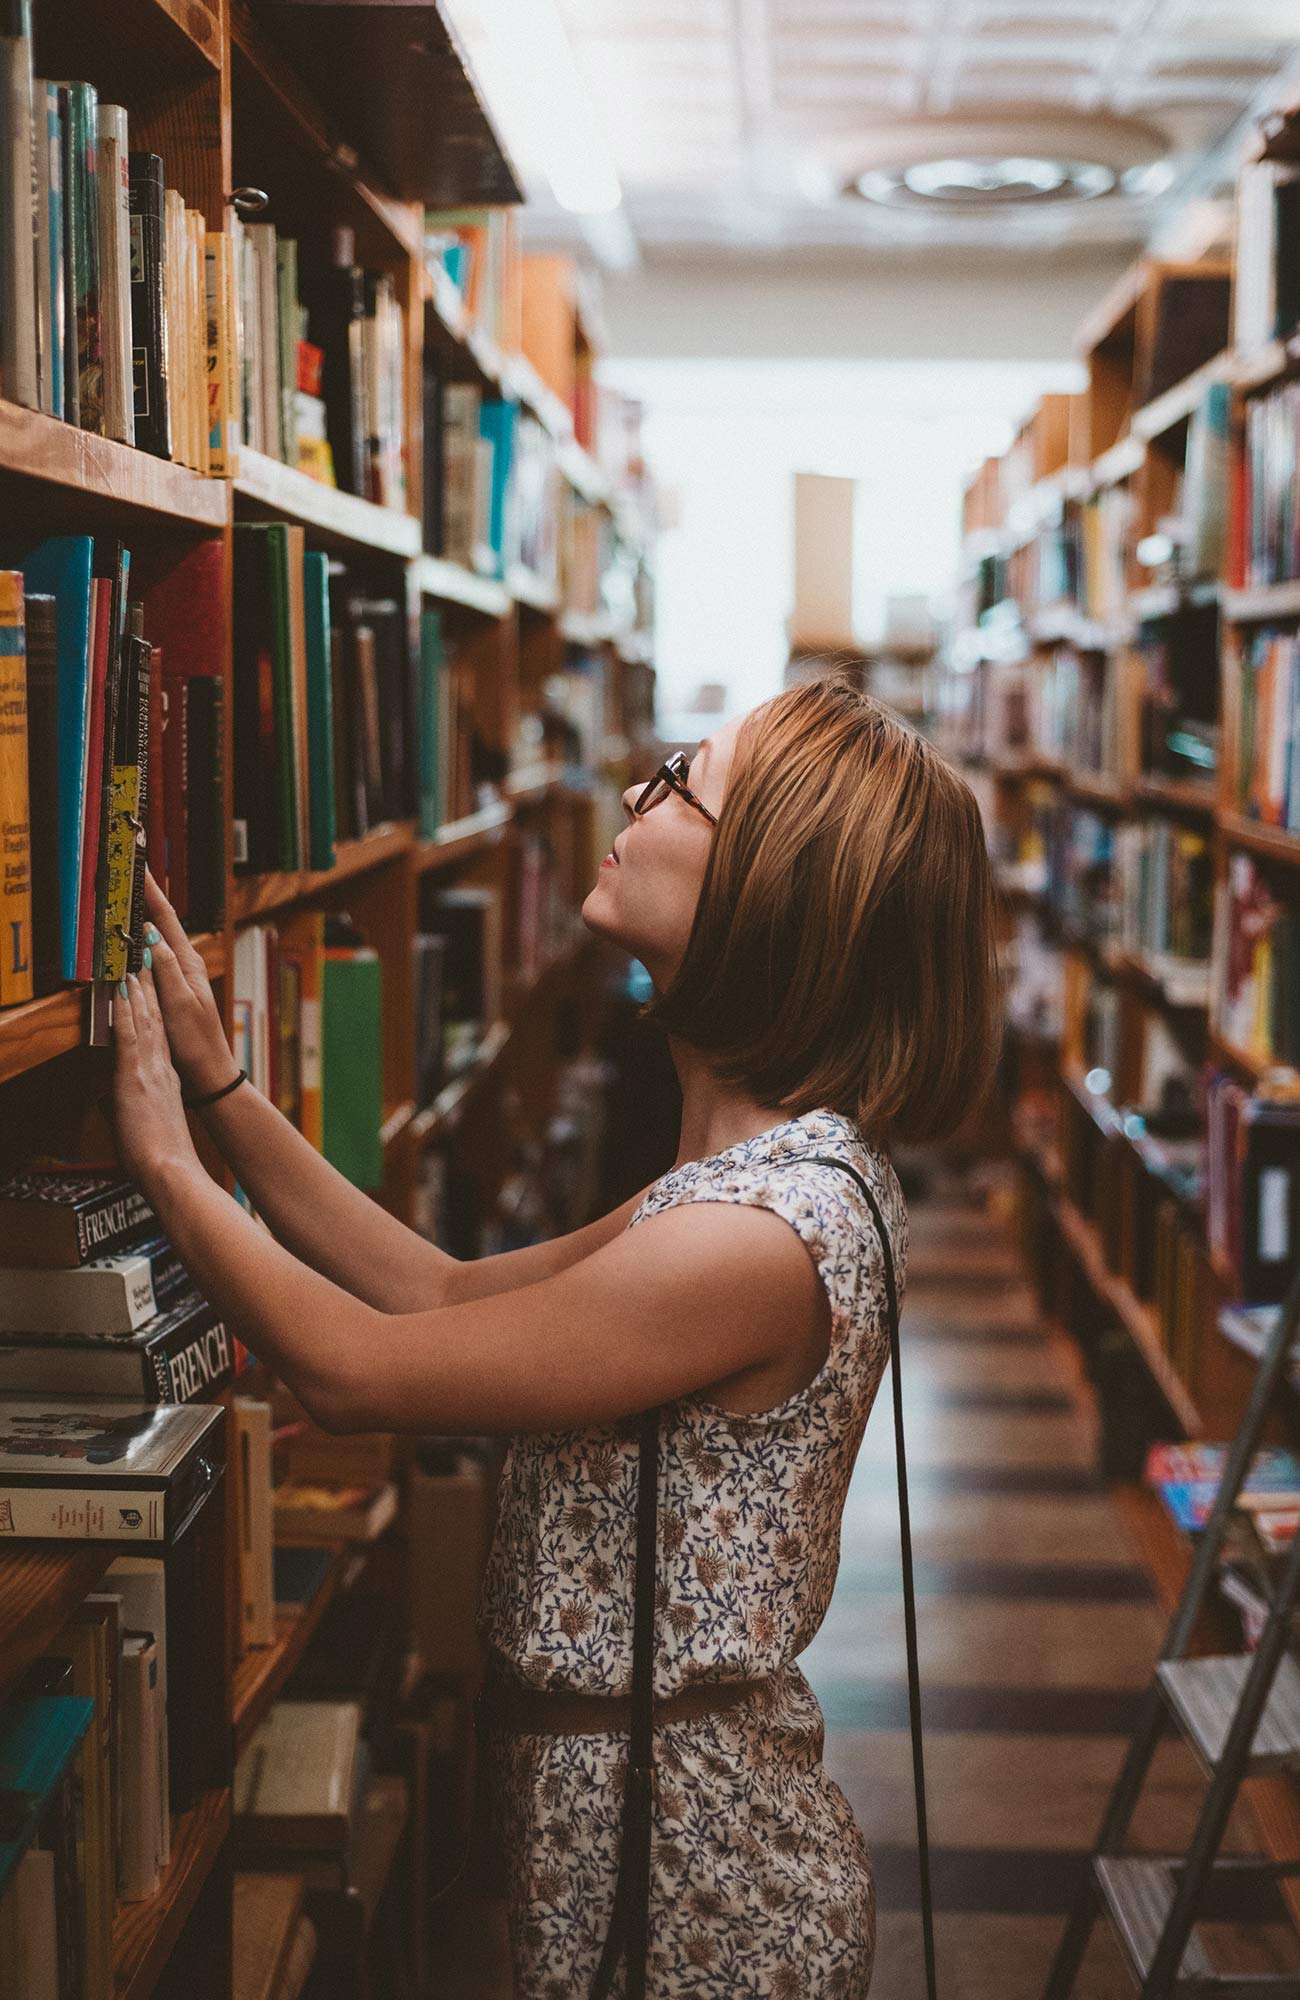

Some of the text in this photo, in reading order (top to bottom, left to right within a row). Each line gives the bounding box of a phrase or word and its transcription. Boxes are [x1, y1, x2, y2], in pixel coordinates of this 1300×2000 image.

[10, 921, 28, 974] L
[77, 1212, 88, 1257] Oxford
[85, 1199, 128, 1246] FRENCH
[169, 1322, 230, 1404] FRENCH
